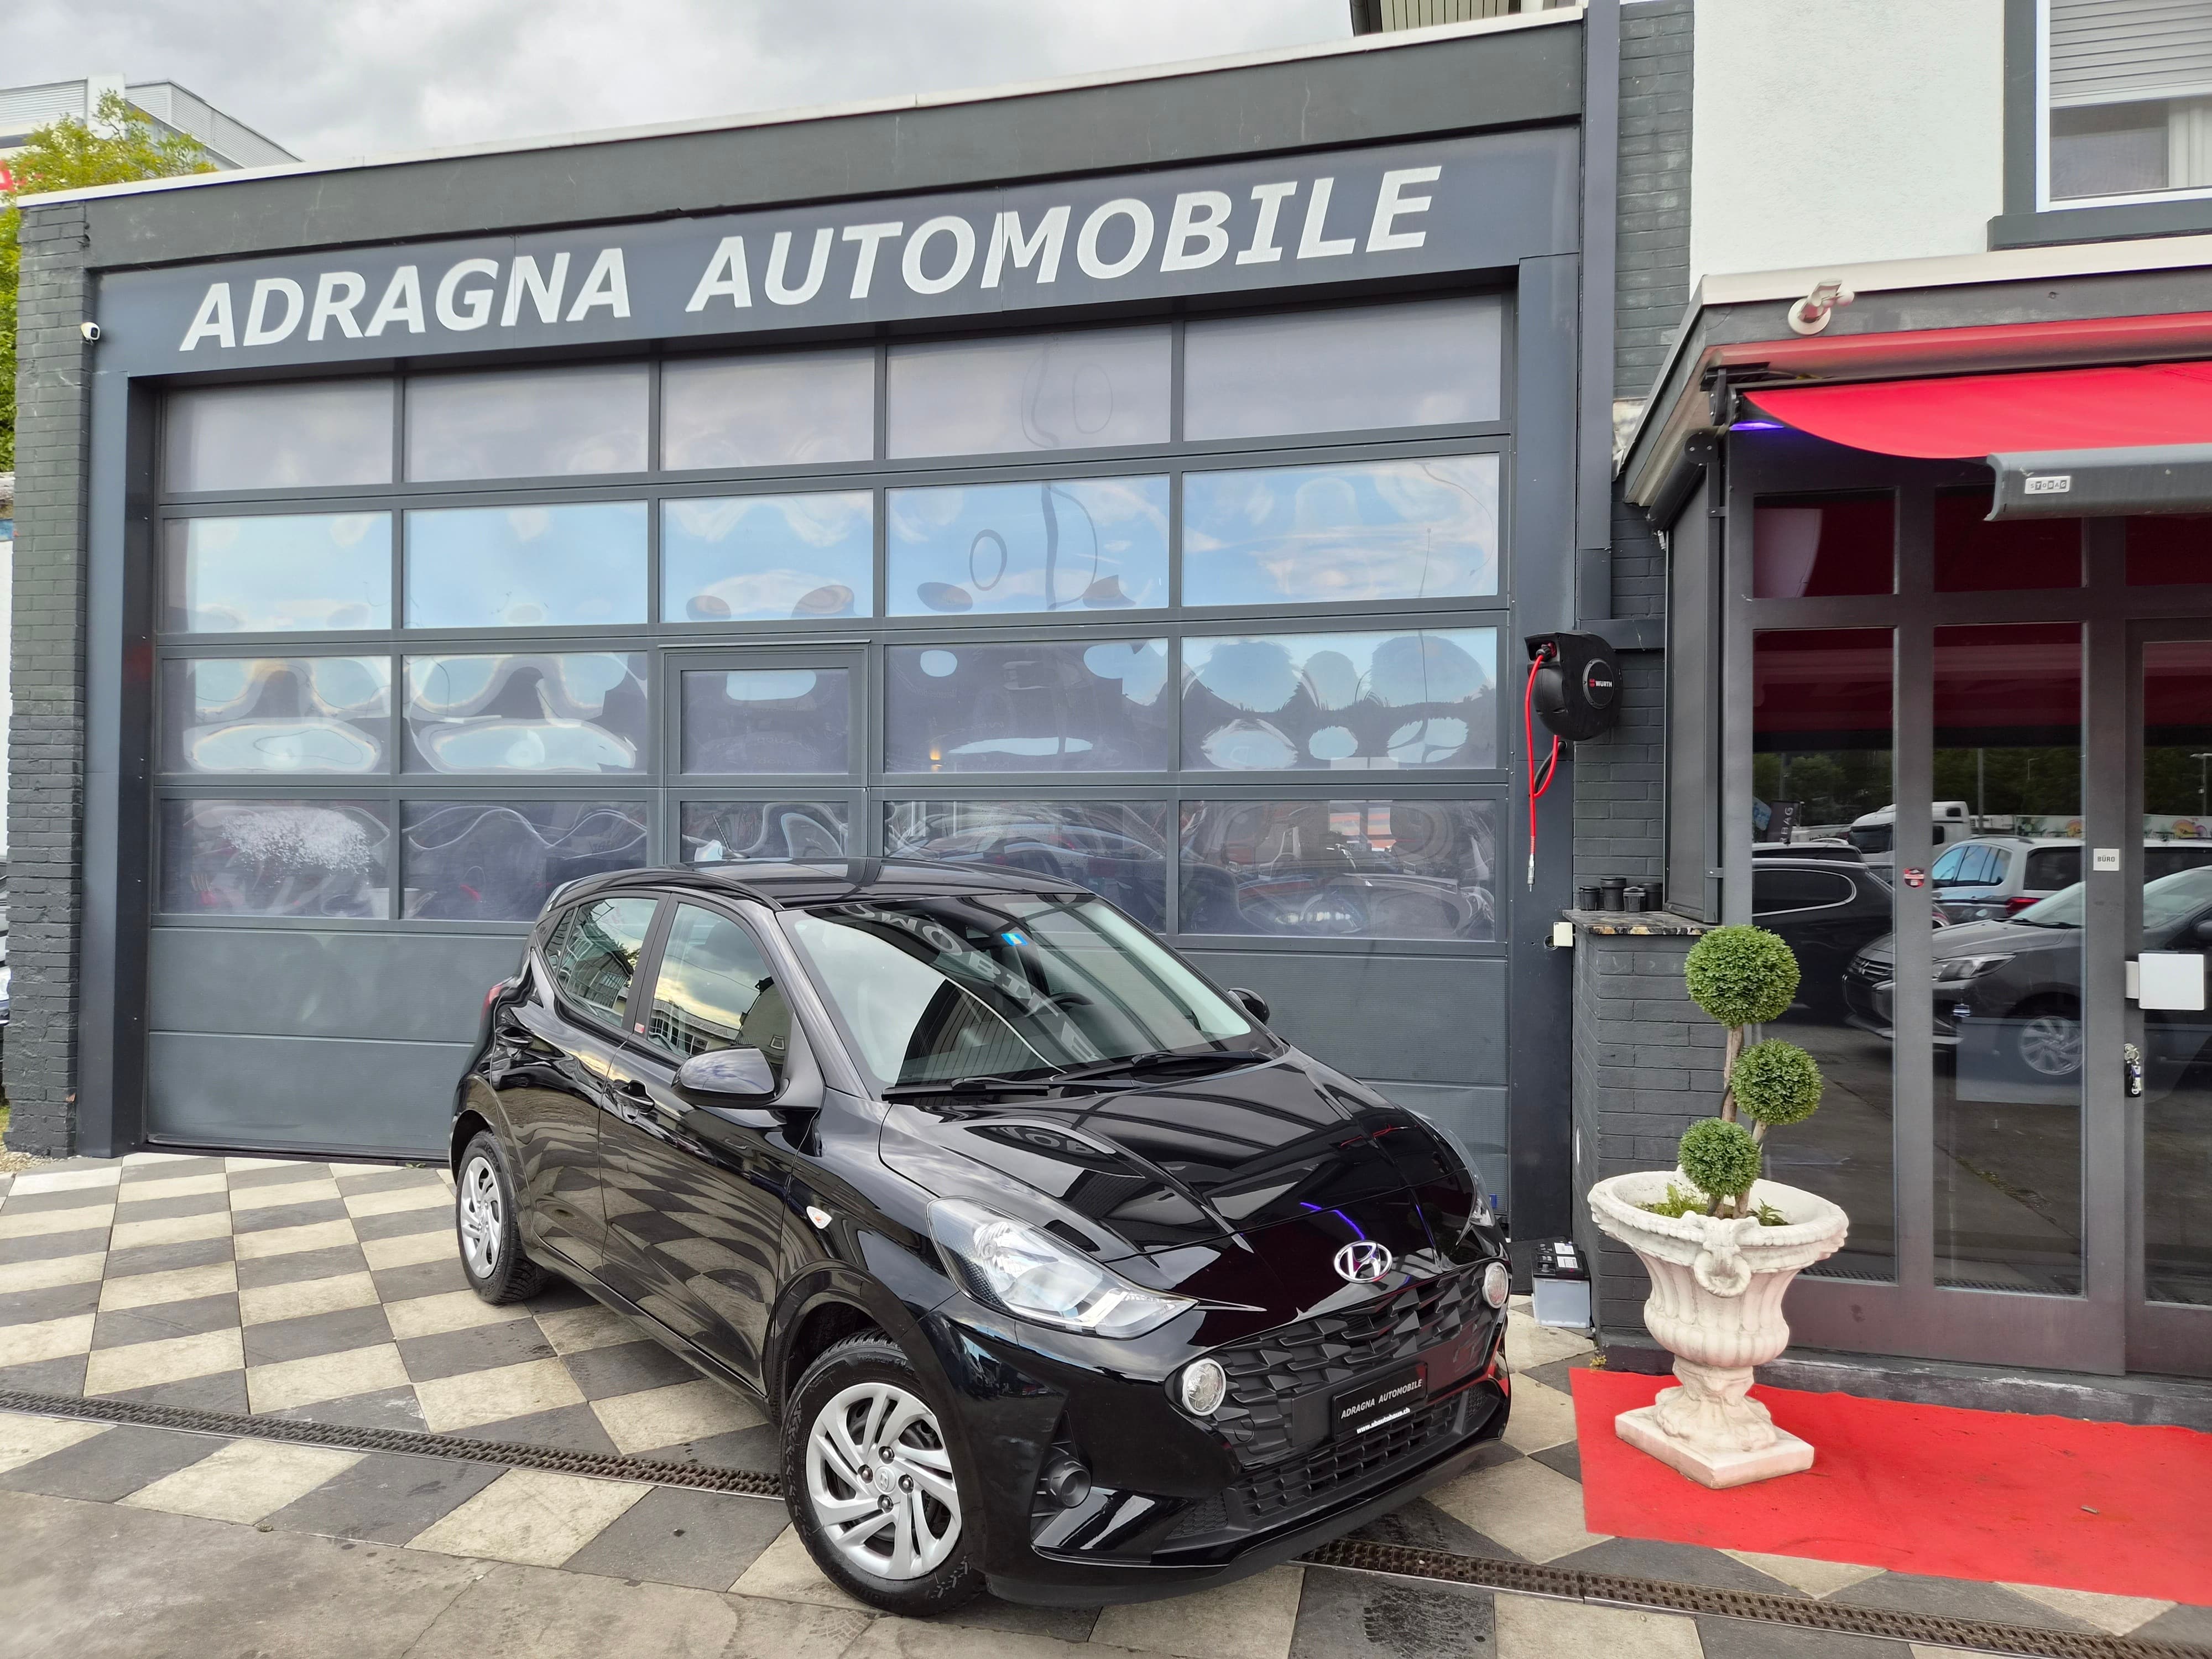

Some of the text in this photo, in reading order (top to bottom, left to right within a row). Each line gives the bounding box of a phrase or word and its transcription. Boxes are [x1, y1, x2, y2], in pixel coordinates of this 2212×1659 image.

[179, 165, 1442, 351] ADRAGNA AUTOMOBILE
[2030, 480, 2066, 489] STOBAG
[1340, 1379, 1423, 1420] ADRAGNA AUTOMOBILE
